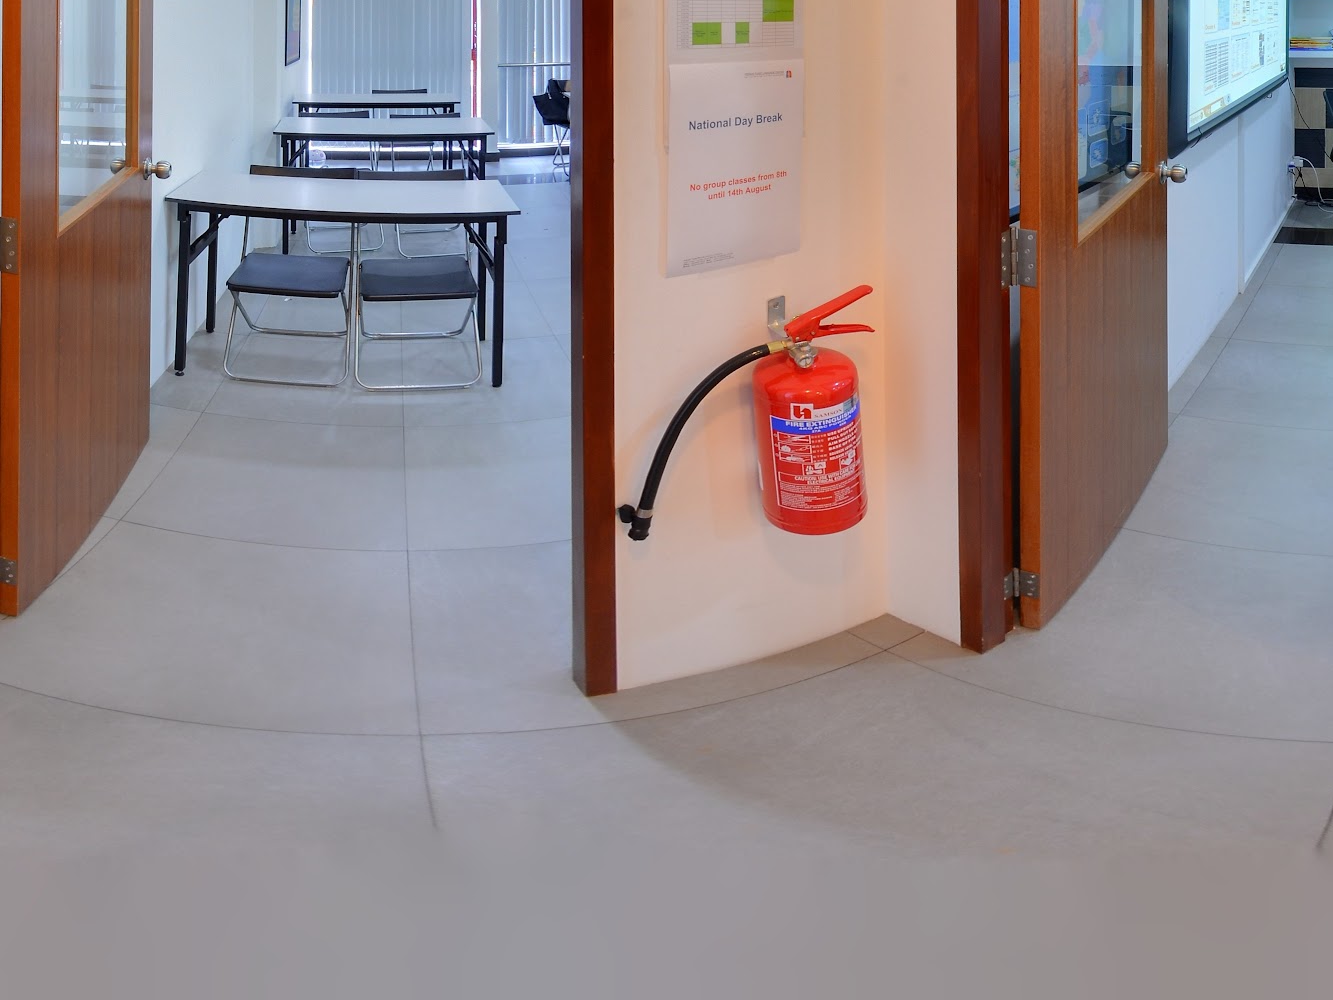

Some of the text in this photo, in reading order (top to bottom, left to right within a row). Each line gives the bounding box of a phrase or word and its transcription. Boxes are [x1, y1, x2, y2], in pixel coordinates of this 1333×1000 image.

[688, 113, 783, 131] National Day Break
[689, 170, 787, 191] No group classes from 8th
[708, 184, 771, 200] until 14th August
[806, 405, 857, 427] EXTINGUISHER
